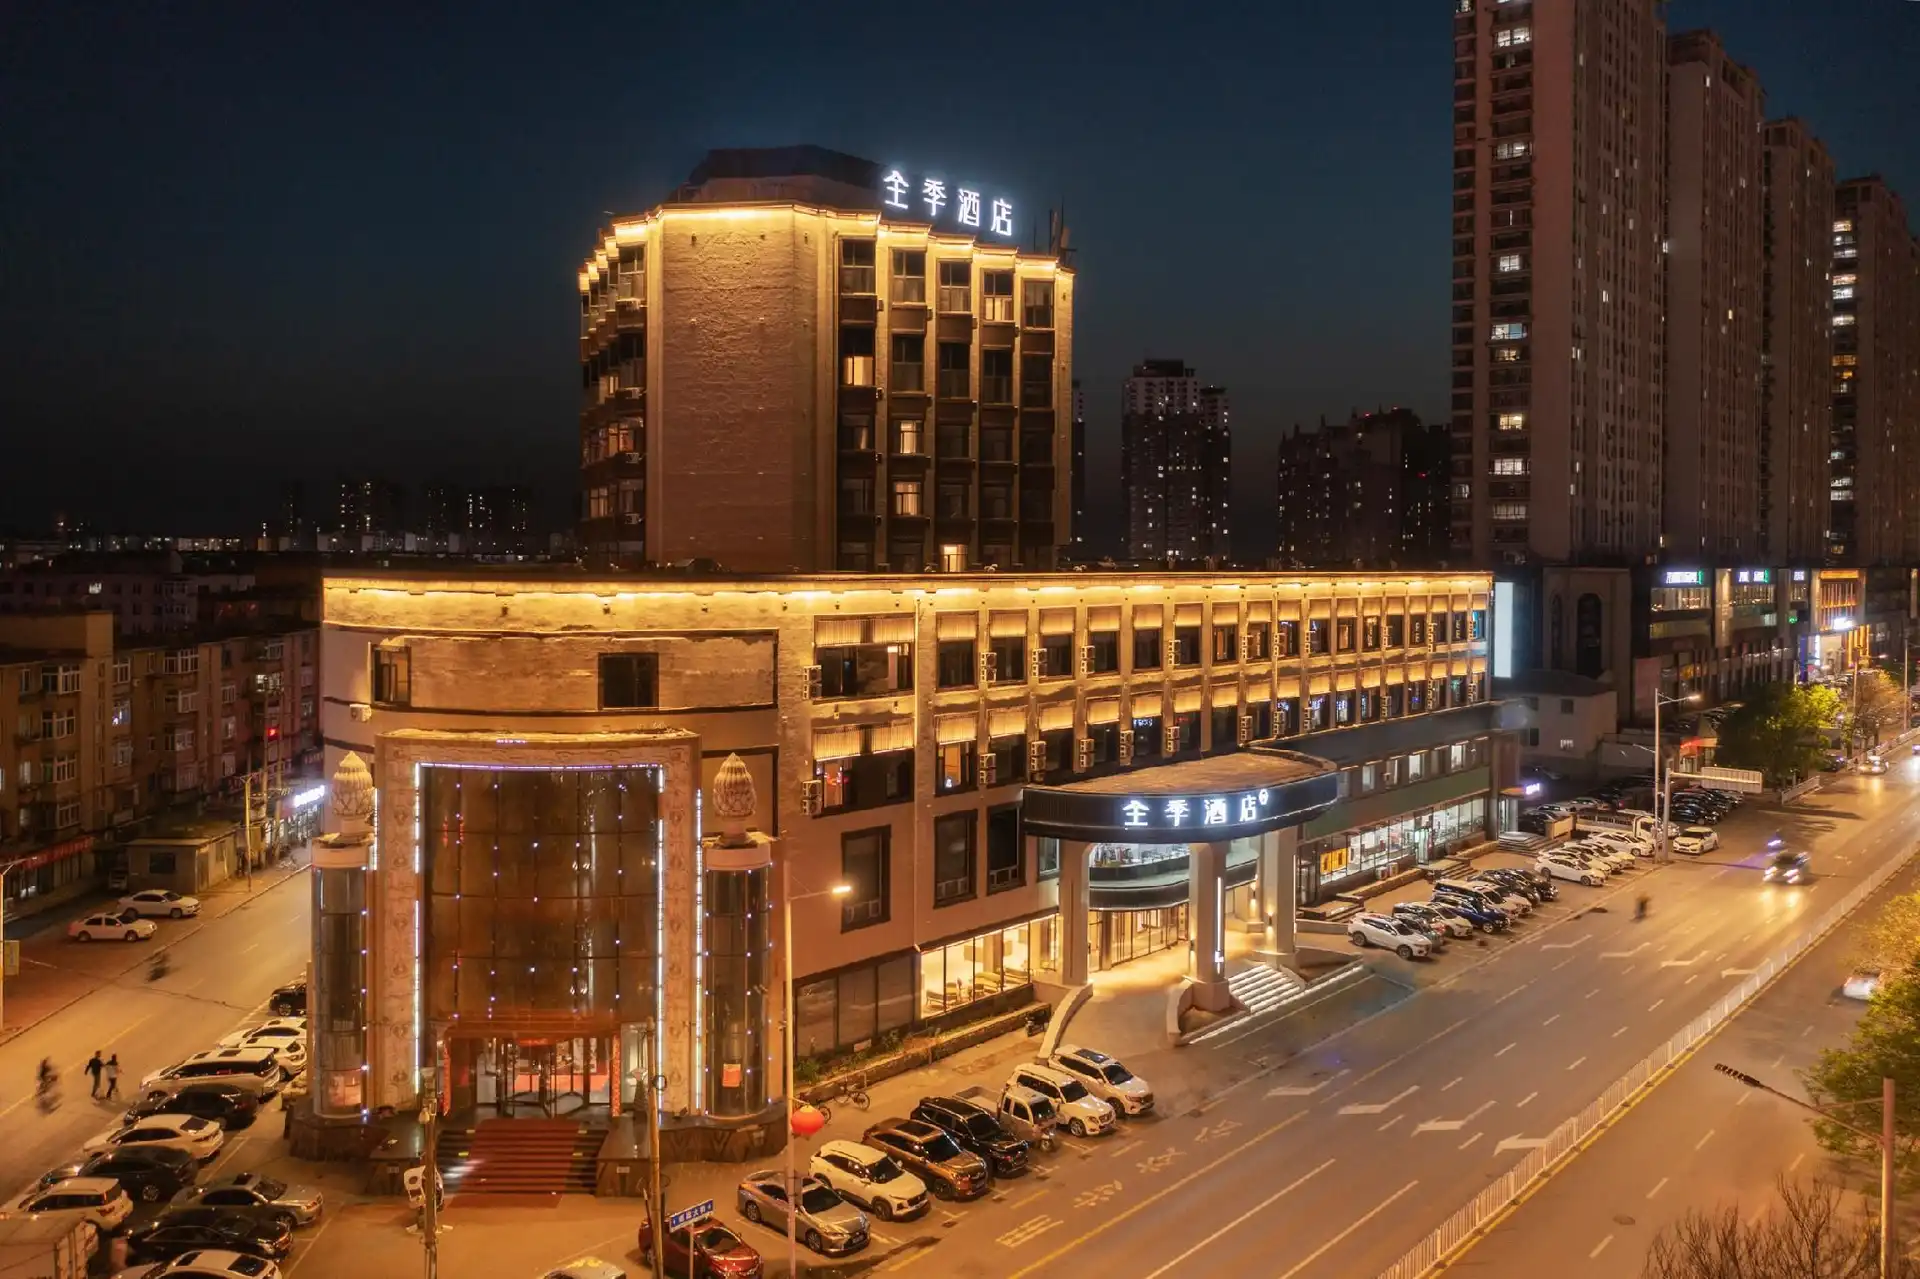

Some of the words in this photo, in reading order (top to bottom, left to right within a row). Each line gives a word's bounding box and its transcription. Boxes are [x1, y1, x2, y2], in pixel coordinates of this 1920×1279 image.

[883, 170, 1013, 236] 全季酒店
[1122, 794, 1257, 827] 全季酒店
